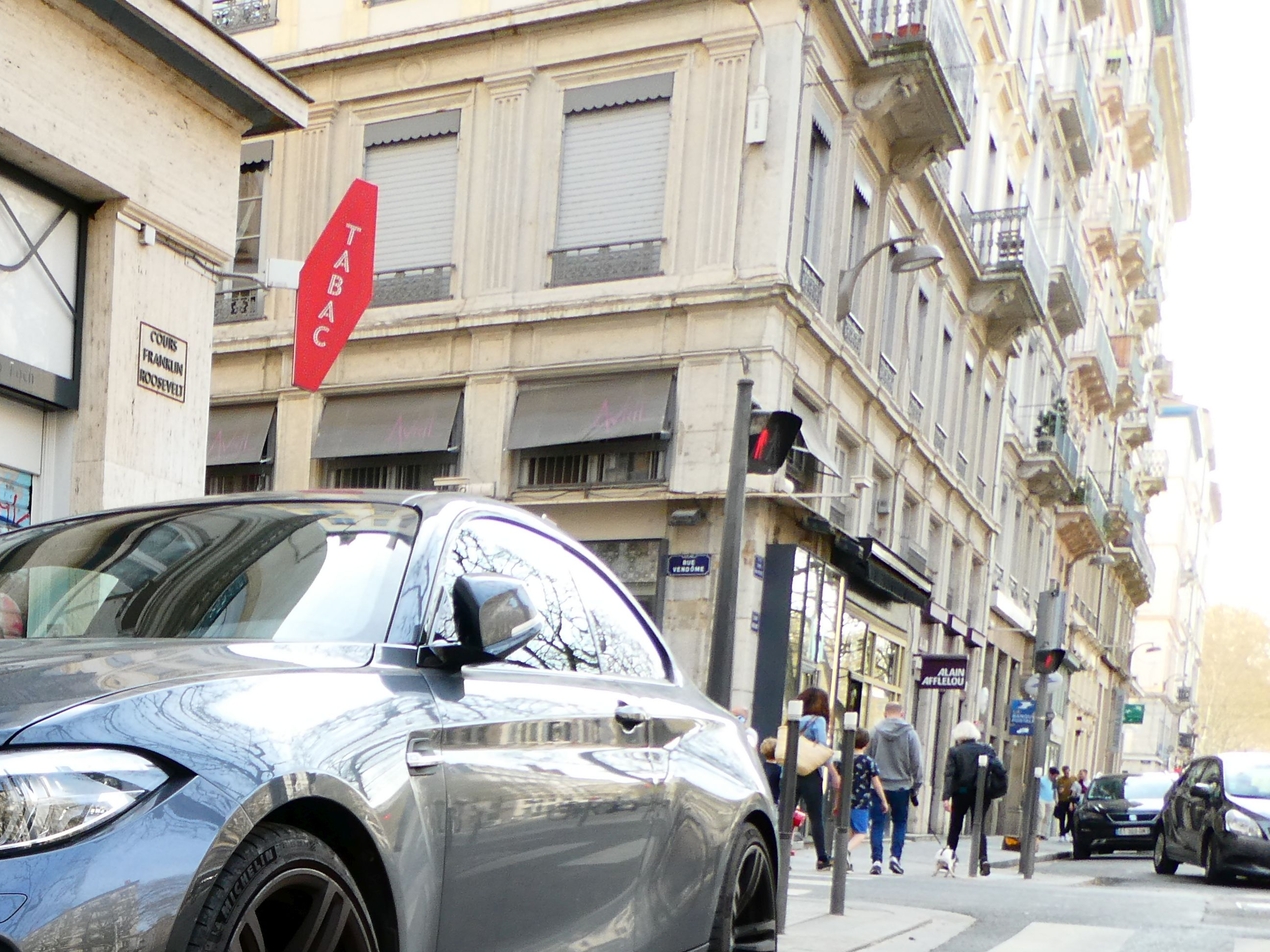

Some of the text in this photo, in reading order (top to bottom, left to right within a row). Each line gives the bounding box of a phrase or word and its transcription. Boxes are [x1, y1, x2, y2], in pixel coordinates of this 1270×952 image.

[312, 222, 362, 348] TABAC
[150, 330, 178, 353] COURS
[142, 347, 184, 377] FRANKLIN
[139, 368, 184, 398] ROOSEVELT
[672, 564, 705, 573] VENDÔME
[682, 559, 696, 567] RUE
[937, 667, 965, 677] ALAIN
[921, 677, 965, 686] AFFLELOU
